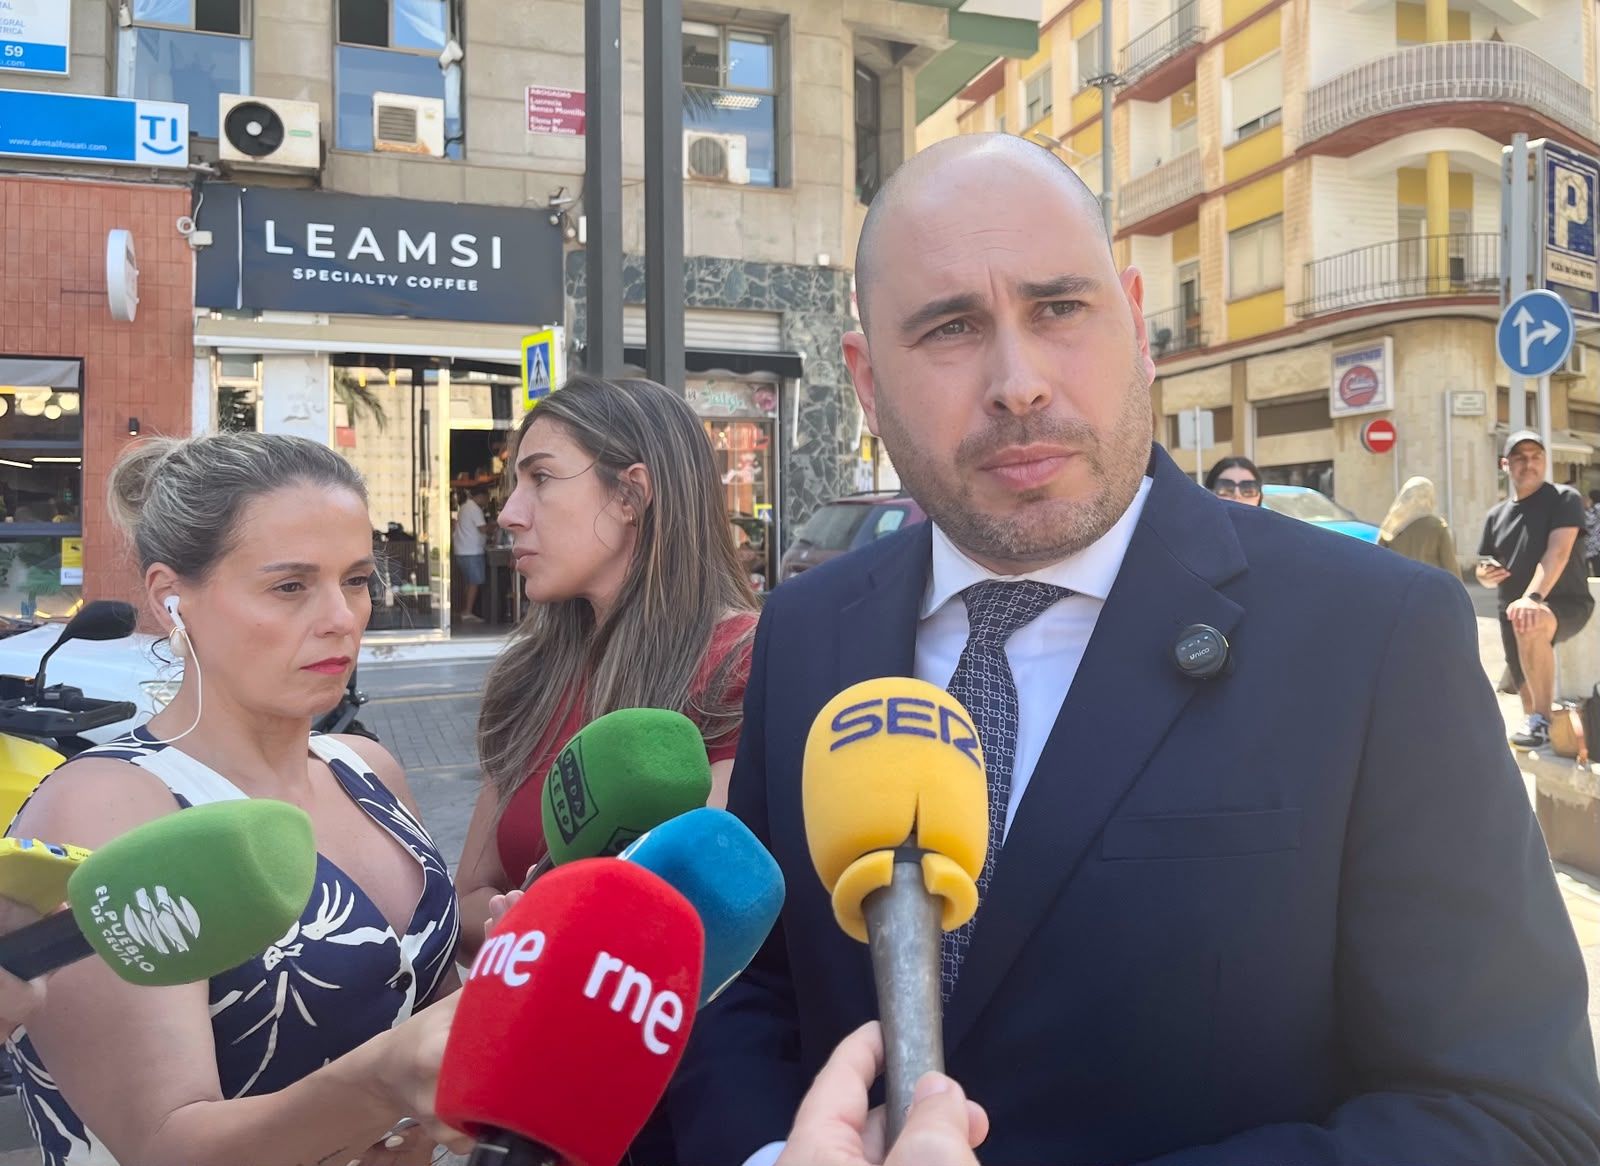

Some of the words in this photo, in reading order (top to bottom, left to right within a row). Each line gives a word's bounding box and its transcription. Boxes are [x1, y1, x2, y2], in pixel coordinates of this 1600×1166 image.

[4, 44, 24, 58] 59
[1554, 166, 1589, 250] P
[265, 219, 501, 270] LEAMSI
[293, 267, 398, 287] SPECIALTY
[406, 275, 479, 292] COFFEE
[830, 697, 982, 771] SER
[552, 768, 571, 826] CERO
[564, 753, 584, 813] ONDA
[90, 904, 106, 924] DE
[102, 928, 133, 966] CEUTA
[95, 885, 111, 907] EL
[104, 911, 155, 973] PUEBLO
[469, 929, 546, 987] rne
[583, 950, 684, 1055] rne
